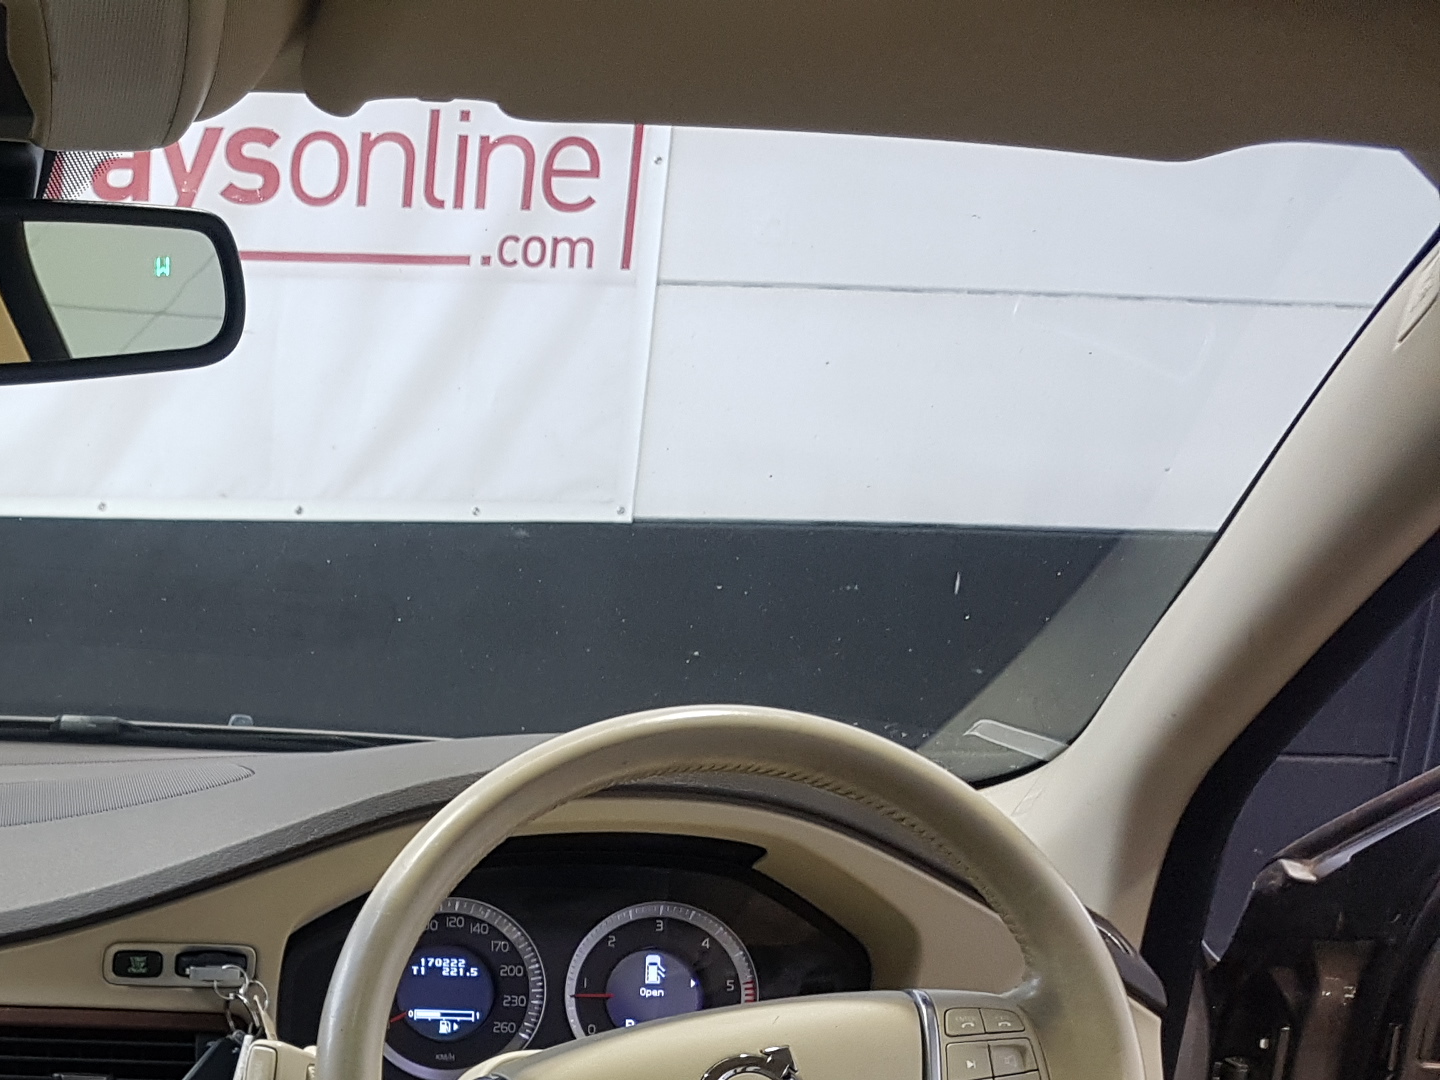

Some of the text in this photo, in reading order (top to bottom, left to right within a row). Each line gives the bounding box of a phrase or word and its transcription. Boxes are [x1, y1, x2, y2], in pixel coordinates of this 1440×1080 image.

[480, 233, 594, 269] .com
[446, 916, 465, 928] 120
[655, 919, 665, 932] 3
[470, 922, 489, 935] 140
[491, 940, 509, 953] 170
[607, 935, 617, 947] 2
[701, 938, 711, 949] 4
[421, 957, 466, 968] 170222
[442, 967, 479, 977] 221.5
[500, 964, 524, 977] 200
[726, 979, 735, 991] 5
[639, 986, 665, 998] Open
[503, 994, 527, 1007] 230
[493, 1021, 516, 1034] 260
